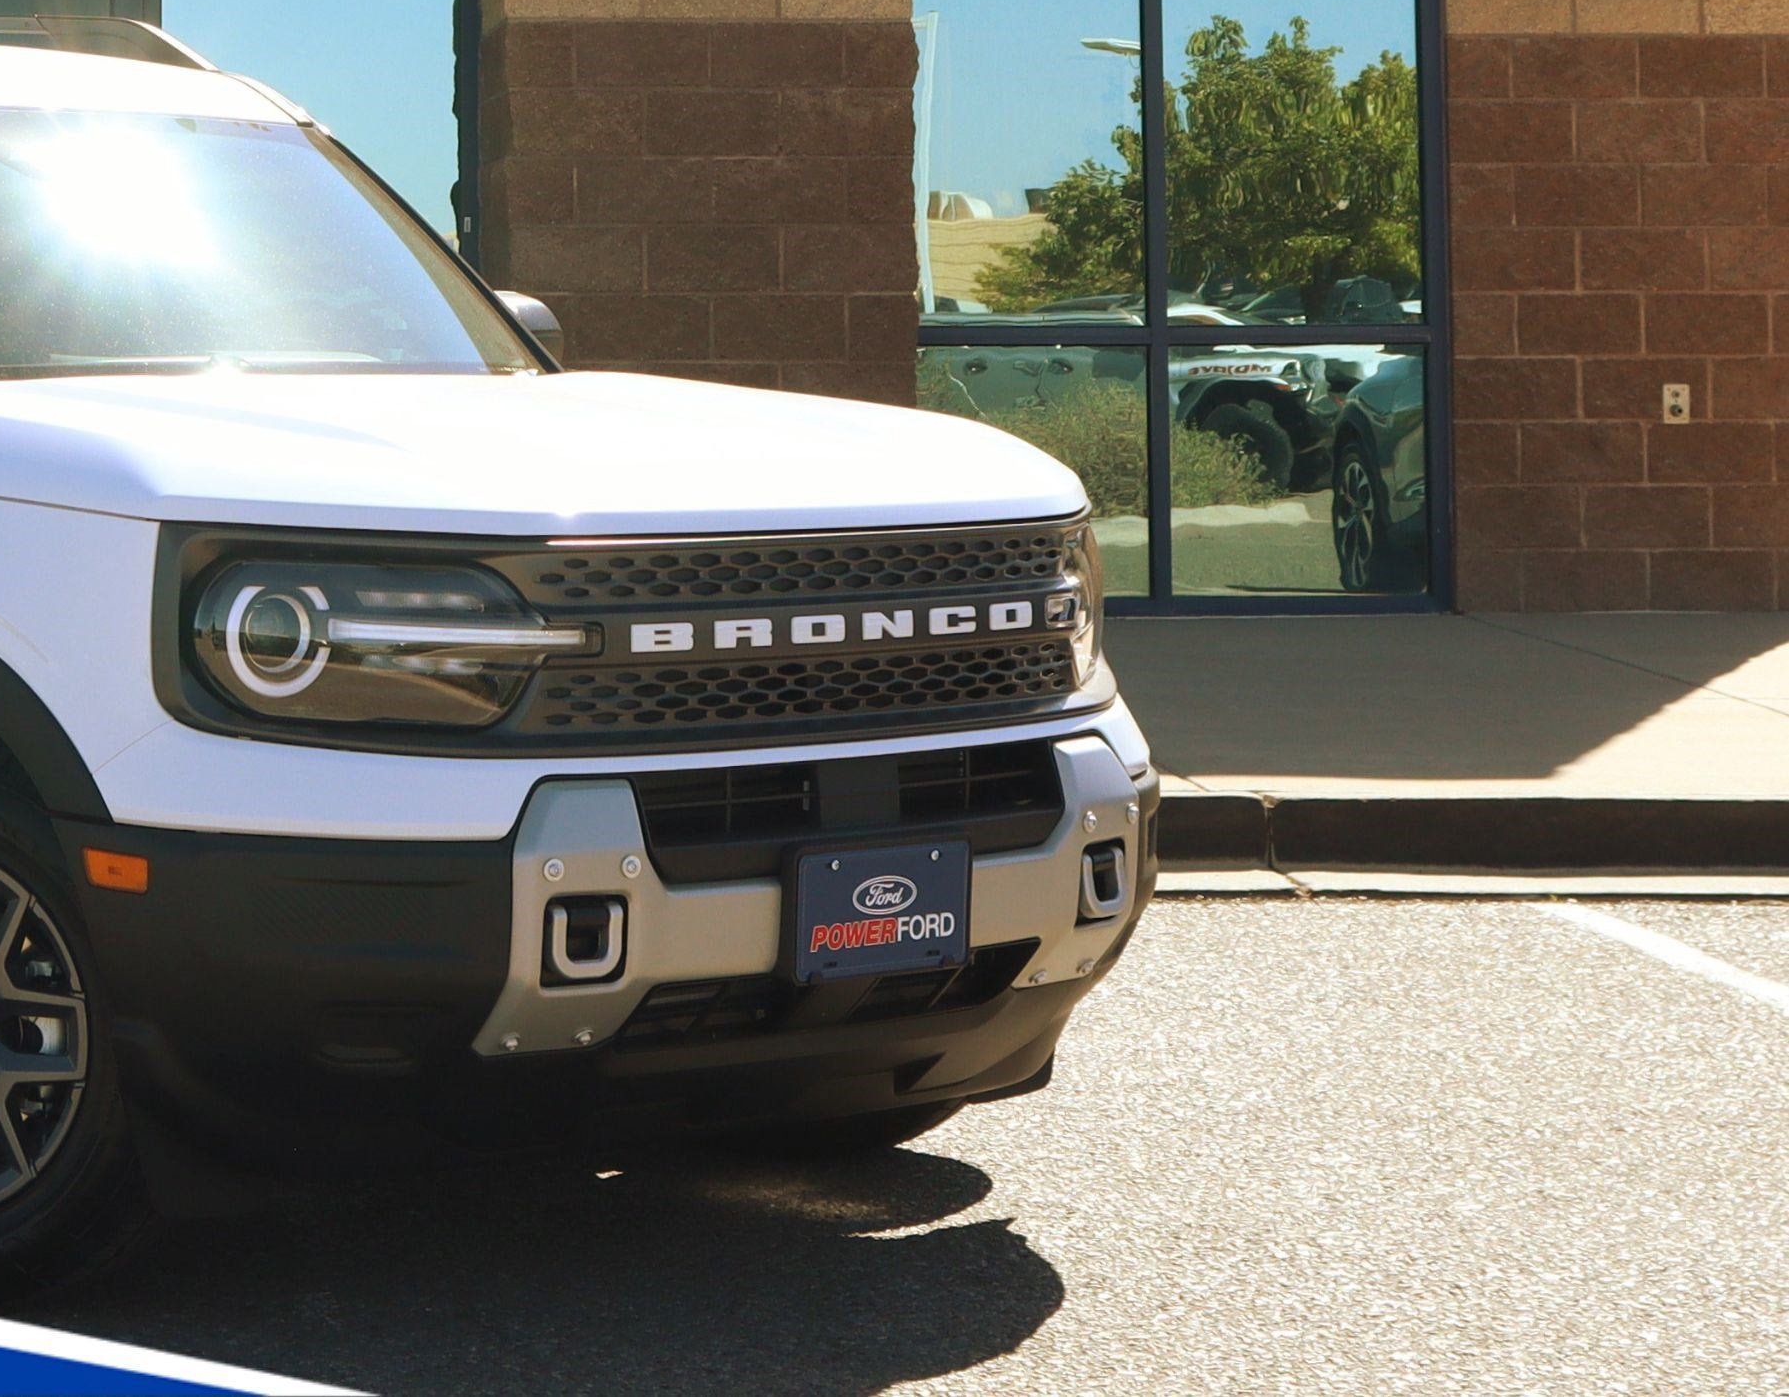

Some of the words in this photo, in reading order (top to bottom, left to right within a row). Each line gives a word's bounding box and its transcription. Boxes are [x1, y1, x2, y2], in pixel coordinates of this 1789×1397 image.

[630, 600, 1033, 653] BRONCO
[865, 882, 904, 907] Ford
[810, 912, 955, 953] POWERFORD
